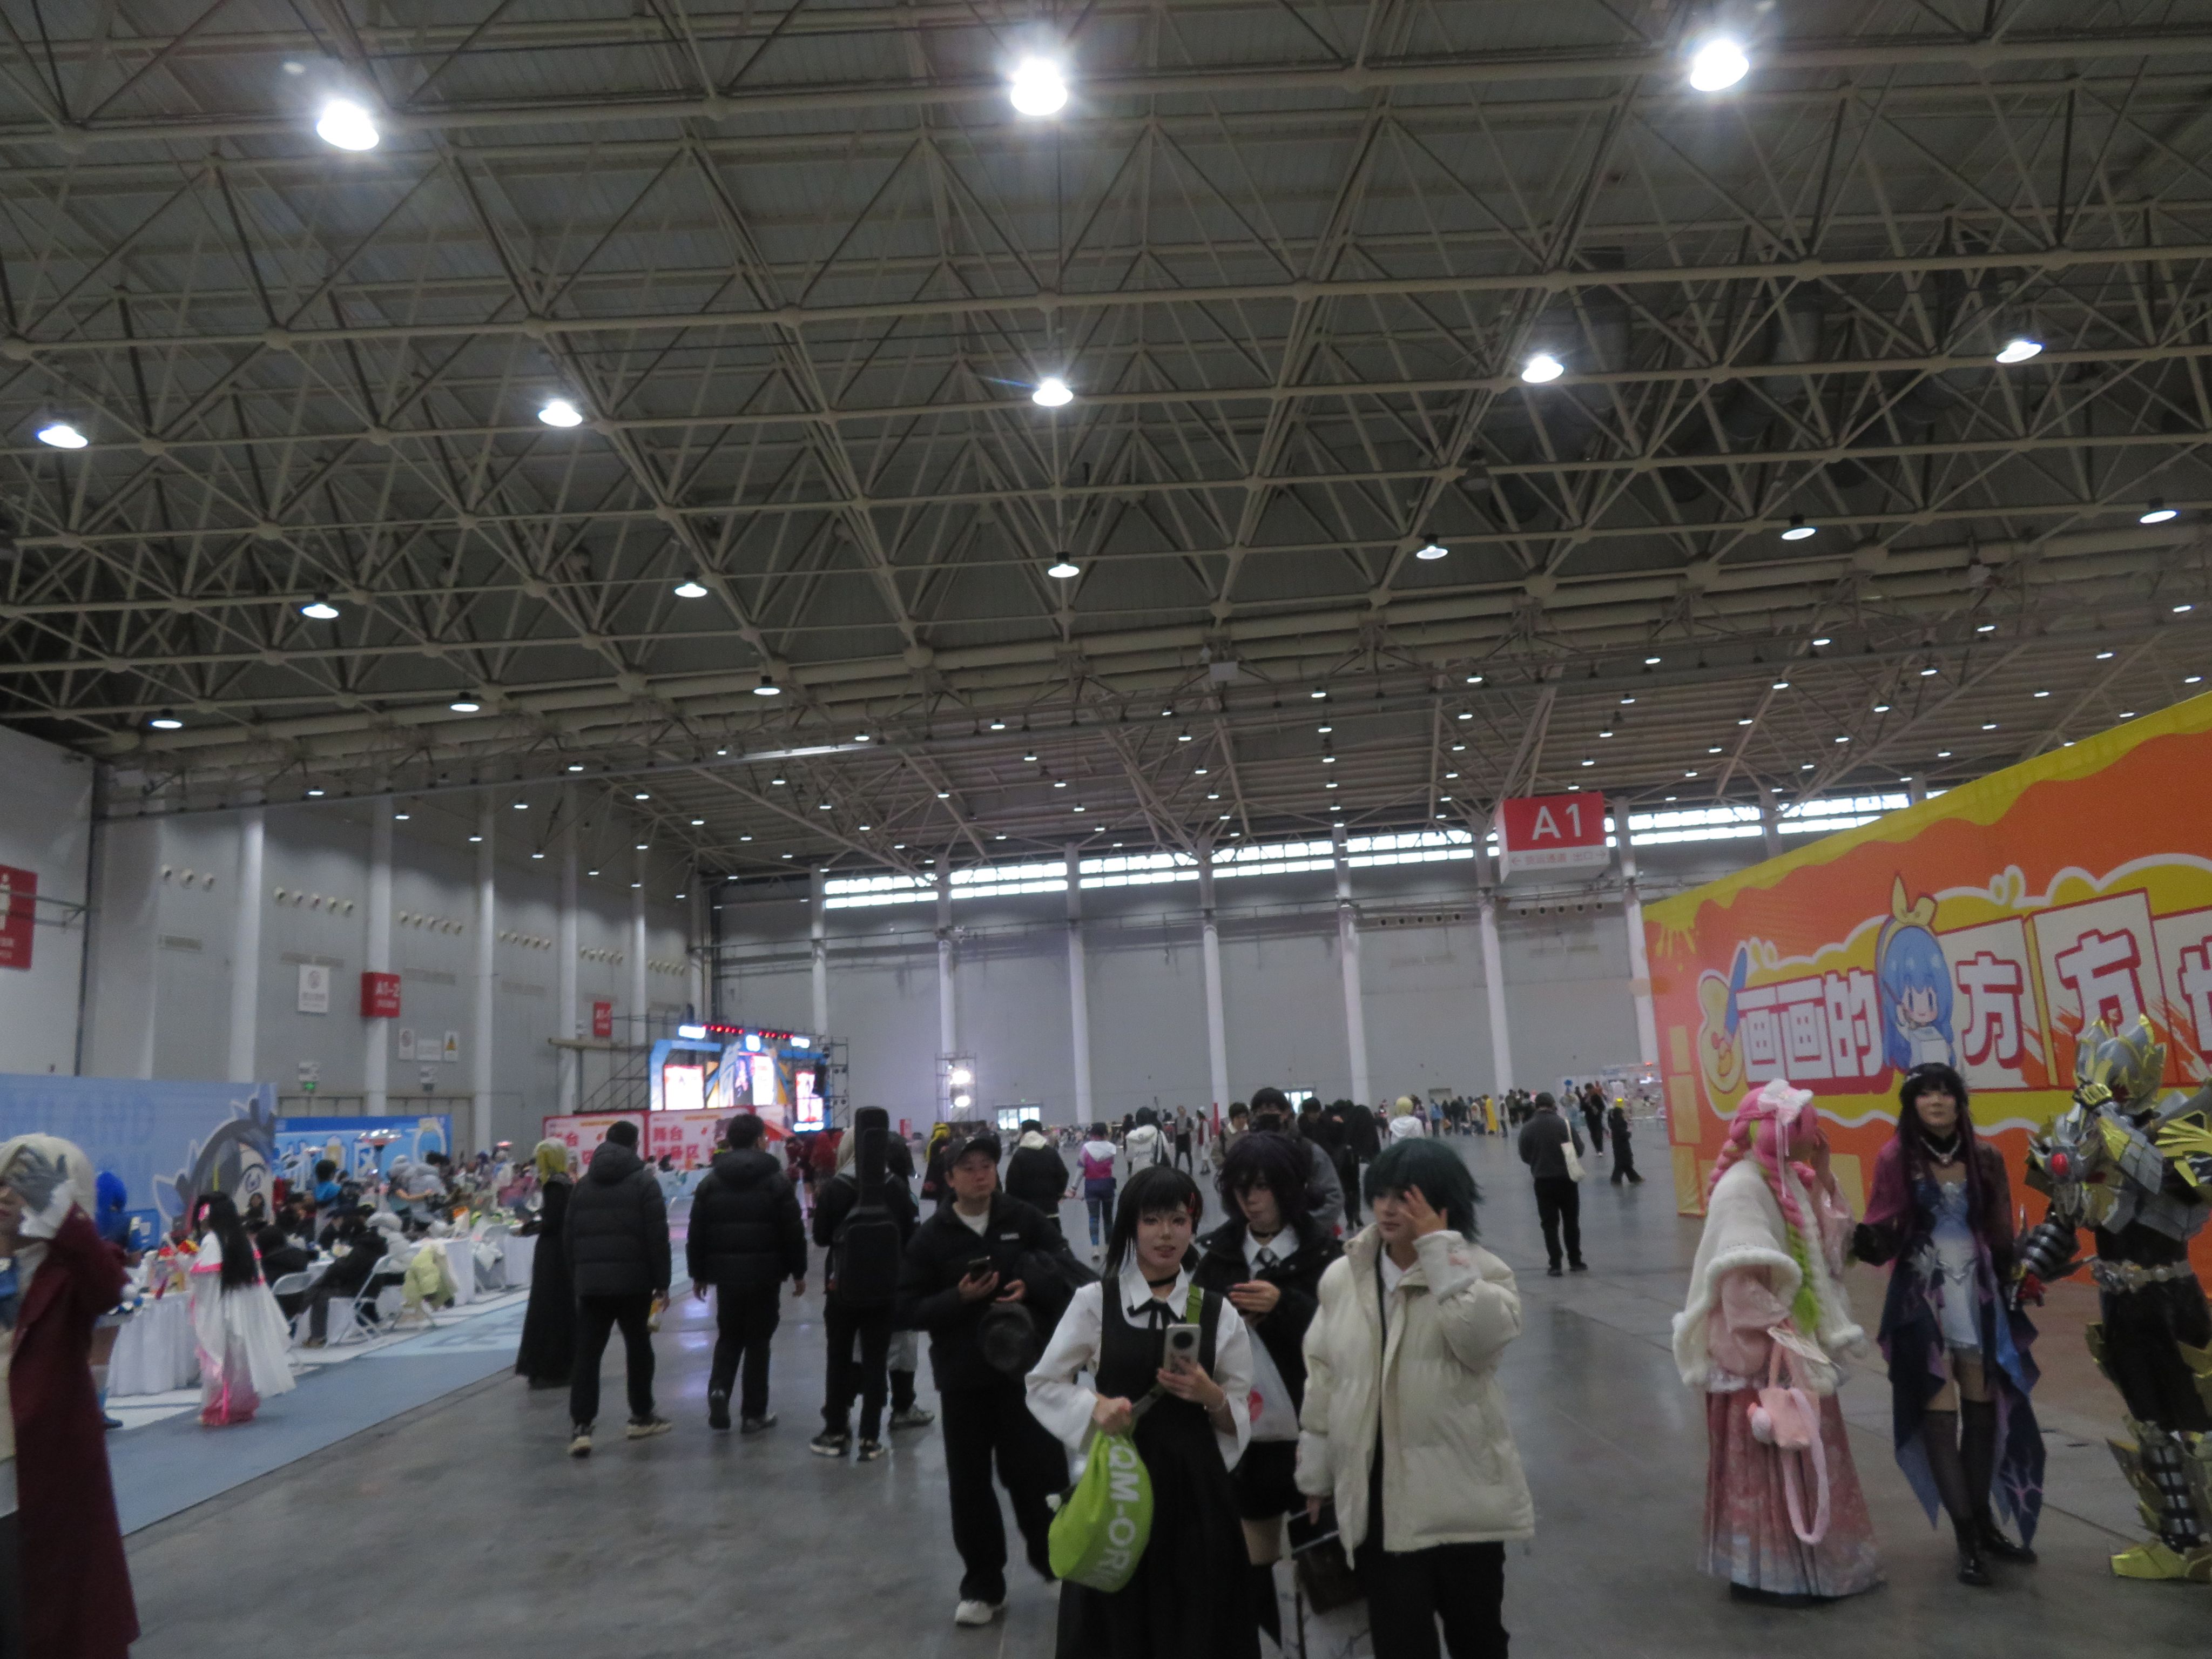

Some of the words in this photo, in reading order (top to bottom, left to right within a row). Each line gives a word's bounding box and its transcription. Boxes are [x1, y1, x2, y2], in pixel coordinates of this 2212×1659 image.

[1532, 803, 1582, 841] A1
[1735, 968, 1883, 1082] 画画的
